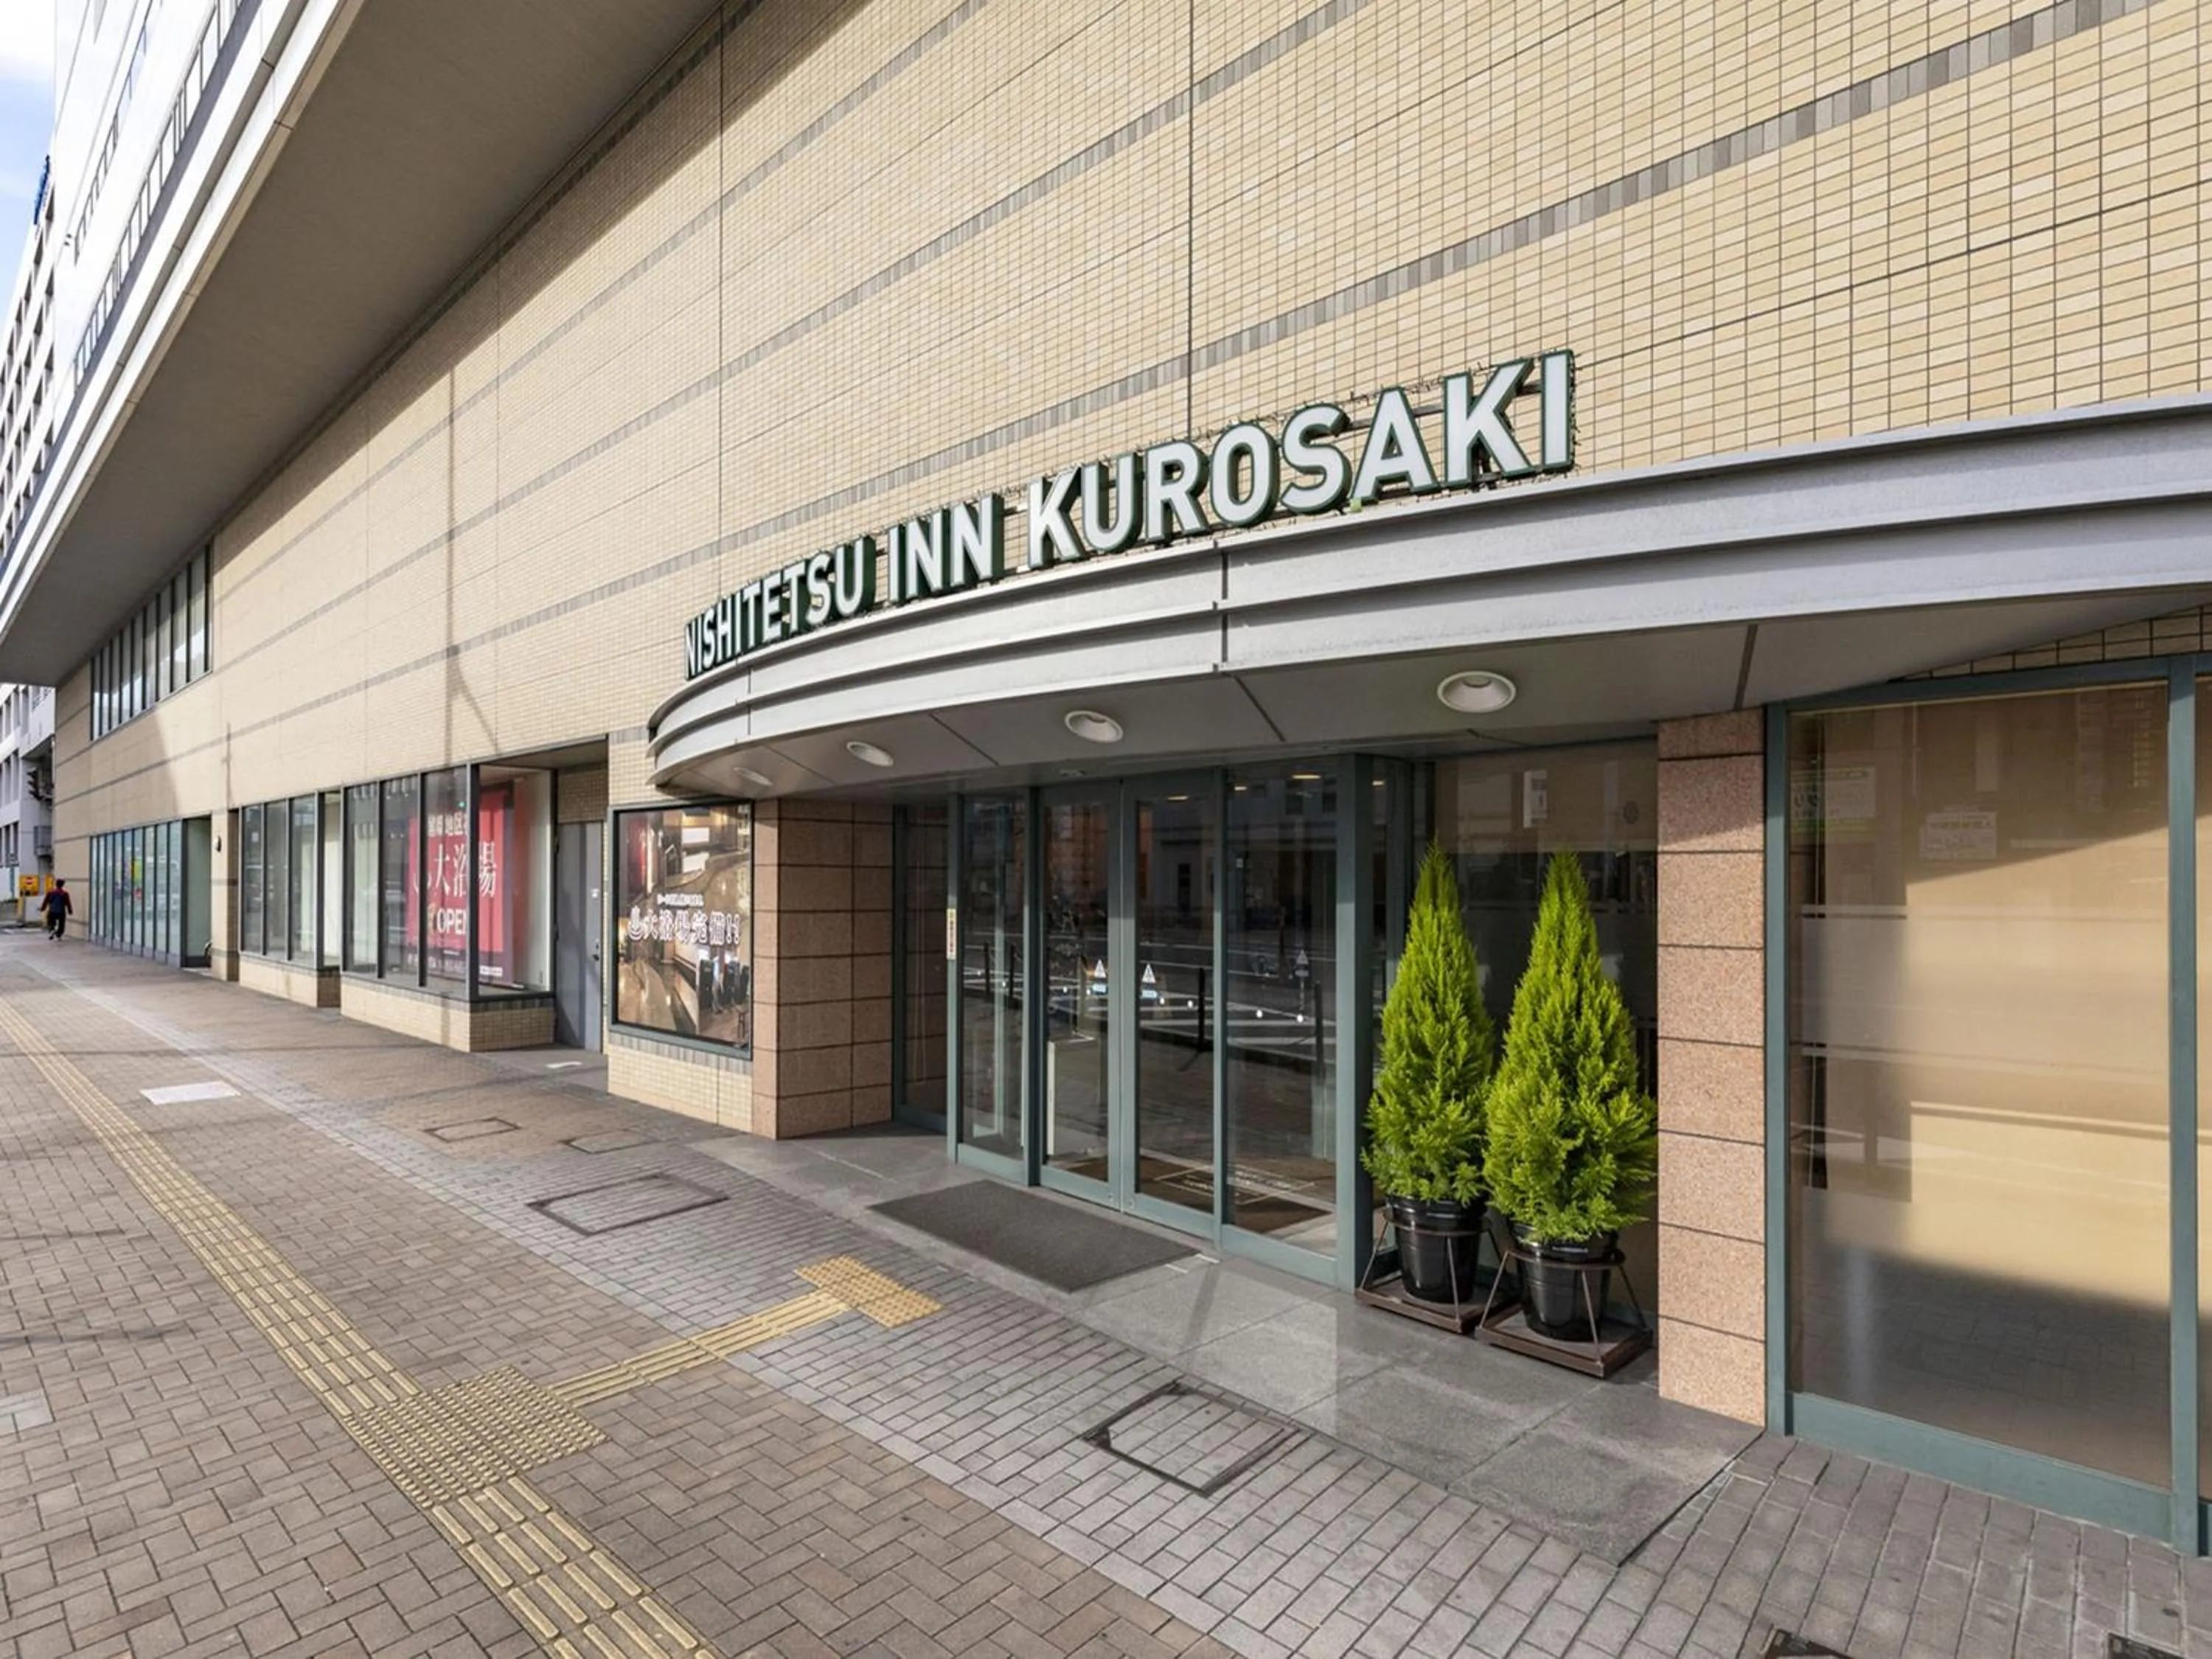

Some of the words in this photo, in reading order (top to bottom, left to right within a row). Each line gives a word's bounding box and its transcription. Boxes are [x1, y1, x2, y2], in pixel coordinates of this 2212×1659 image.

[686, 535, 875, 680] NISHITETSU
[888, 493, 1004, 603] INN
[1028, 349, 1573, 568] KUROSAKI
